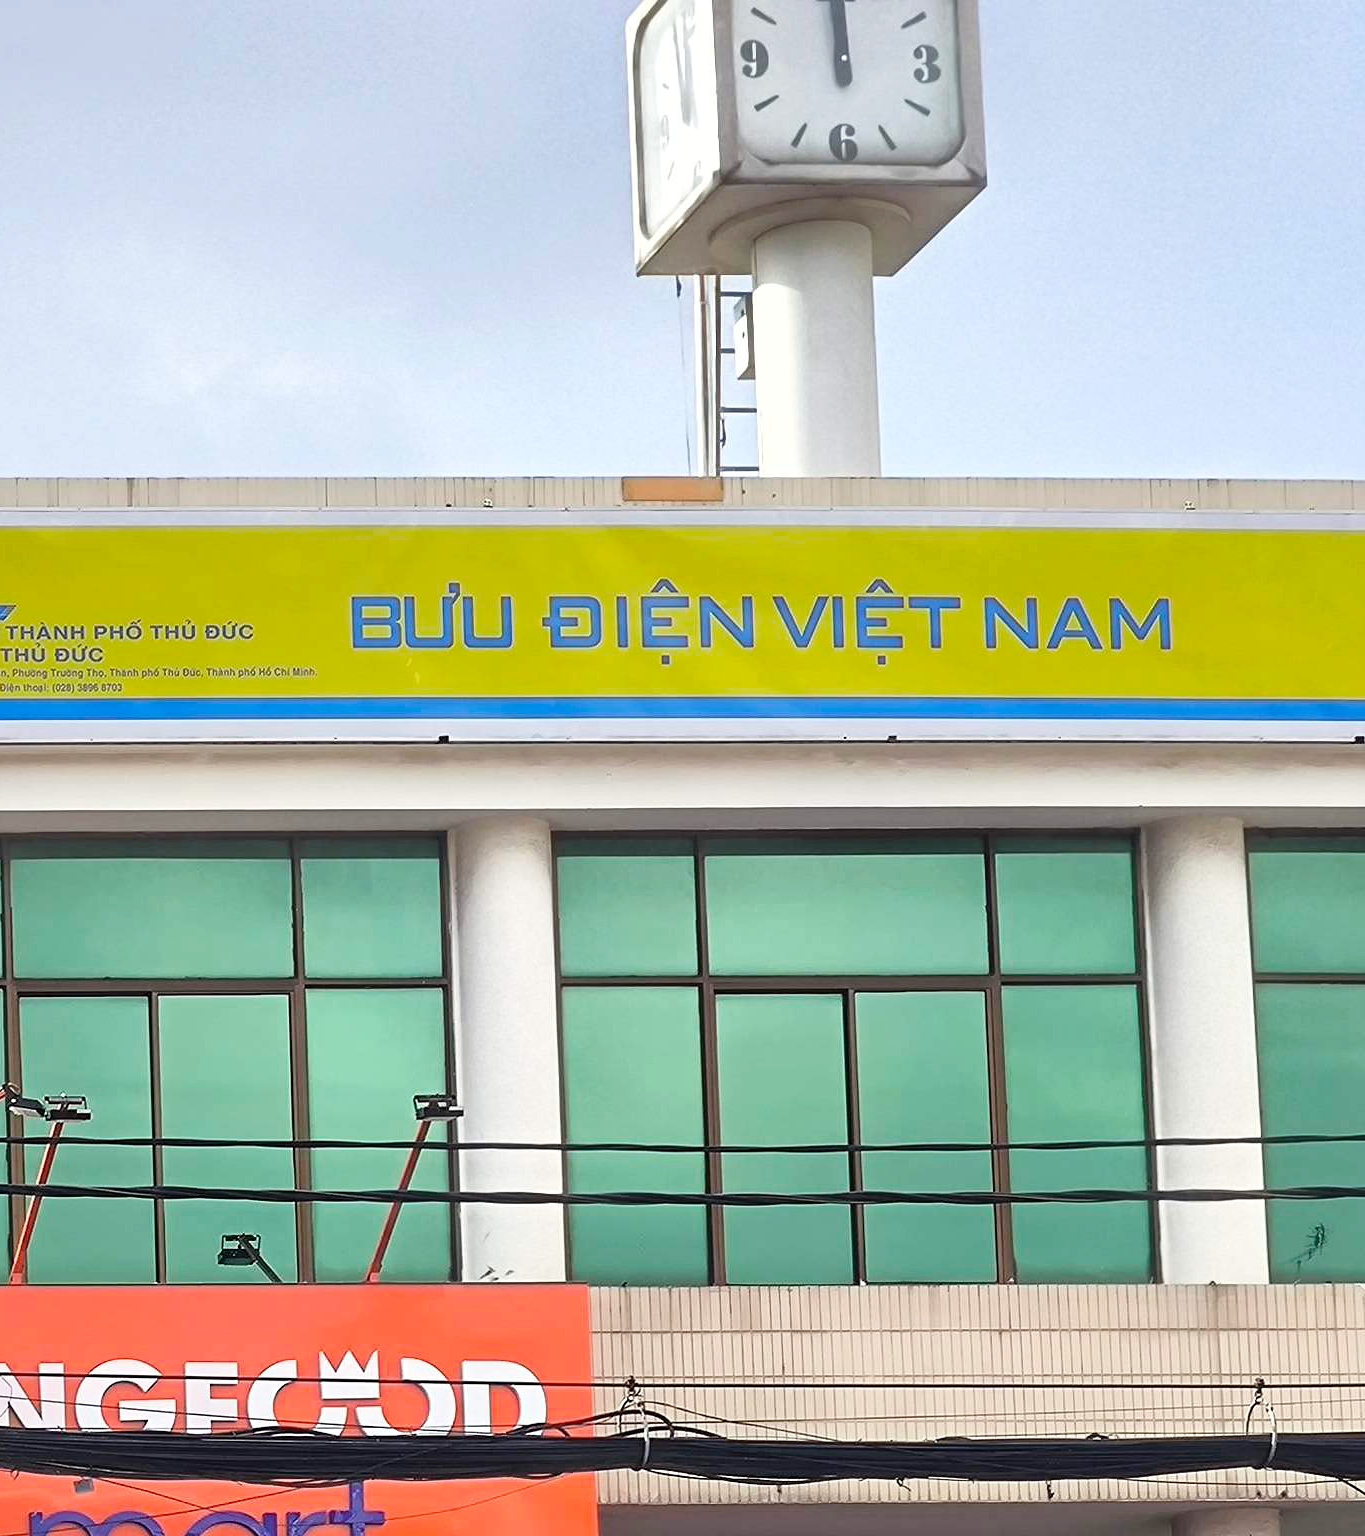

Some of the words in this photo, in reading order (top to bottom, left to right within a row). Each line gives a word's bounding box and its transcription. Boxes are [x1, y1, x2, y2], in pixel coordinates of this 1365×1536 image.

[740, 39, 769, 78] 9
[913, 44, 941, 83] 3
[829, 123, 858, 161] 6
[5, 622, 85, 640] THÀNH
[94, 619, 142, 640] PHỐ
[150, 619, 196, 640] THỦ
[205, 621, 254, 640] ĐỨC
[351, 583, 513, 650] BƯU
[542, 579, 754, 664] ĐIỆN
[772, 579, 960, 664] VIỆT
[983, 596, 1172, 650] NAM
[0, 642, 46, 663] THỦ
[55, 643, 104, 663] ĐỨC
[77, 683, 99, 692] 3896
[101, 683, 122, 692] 8703
